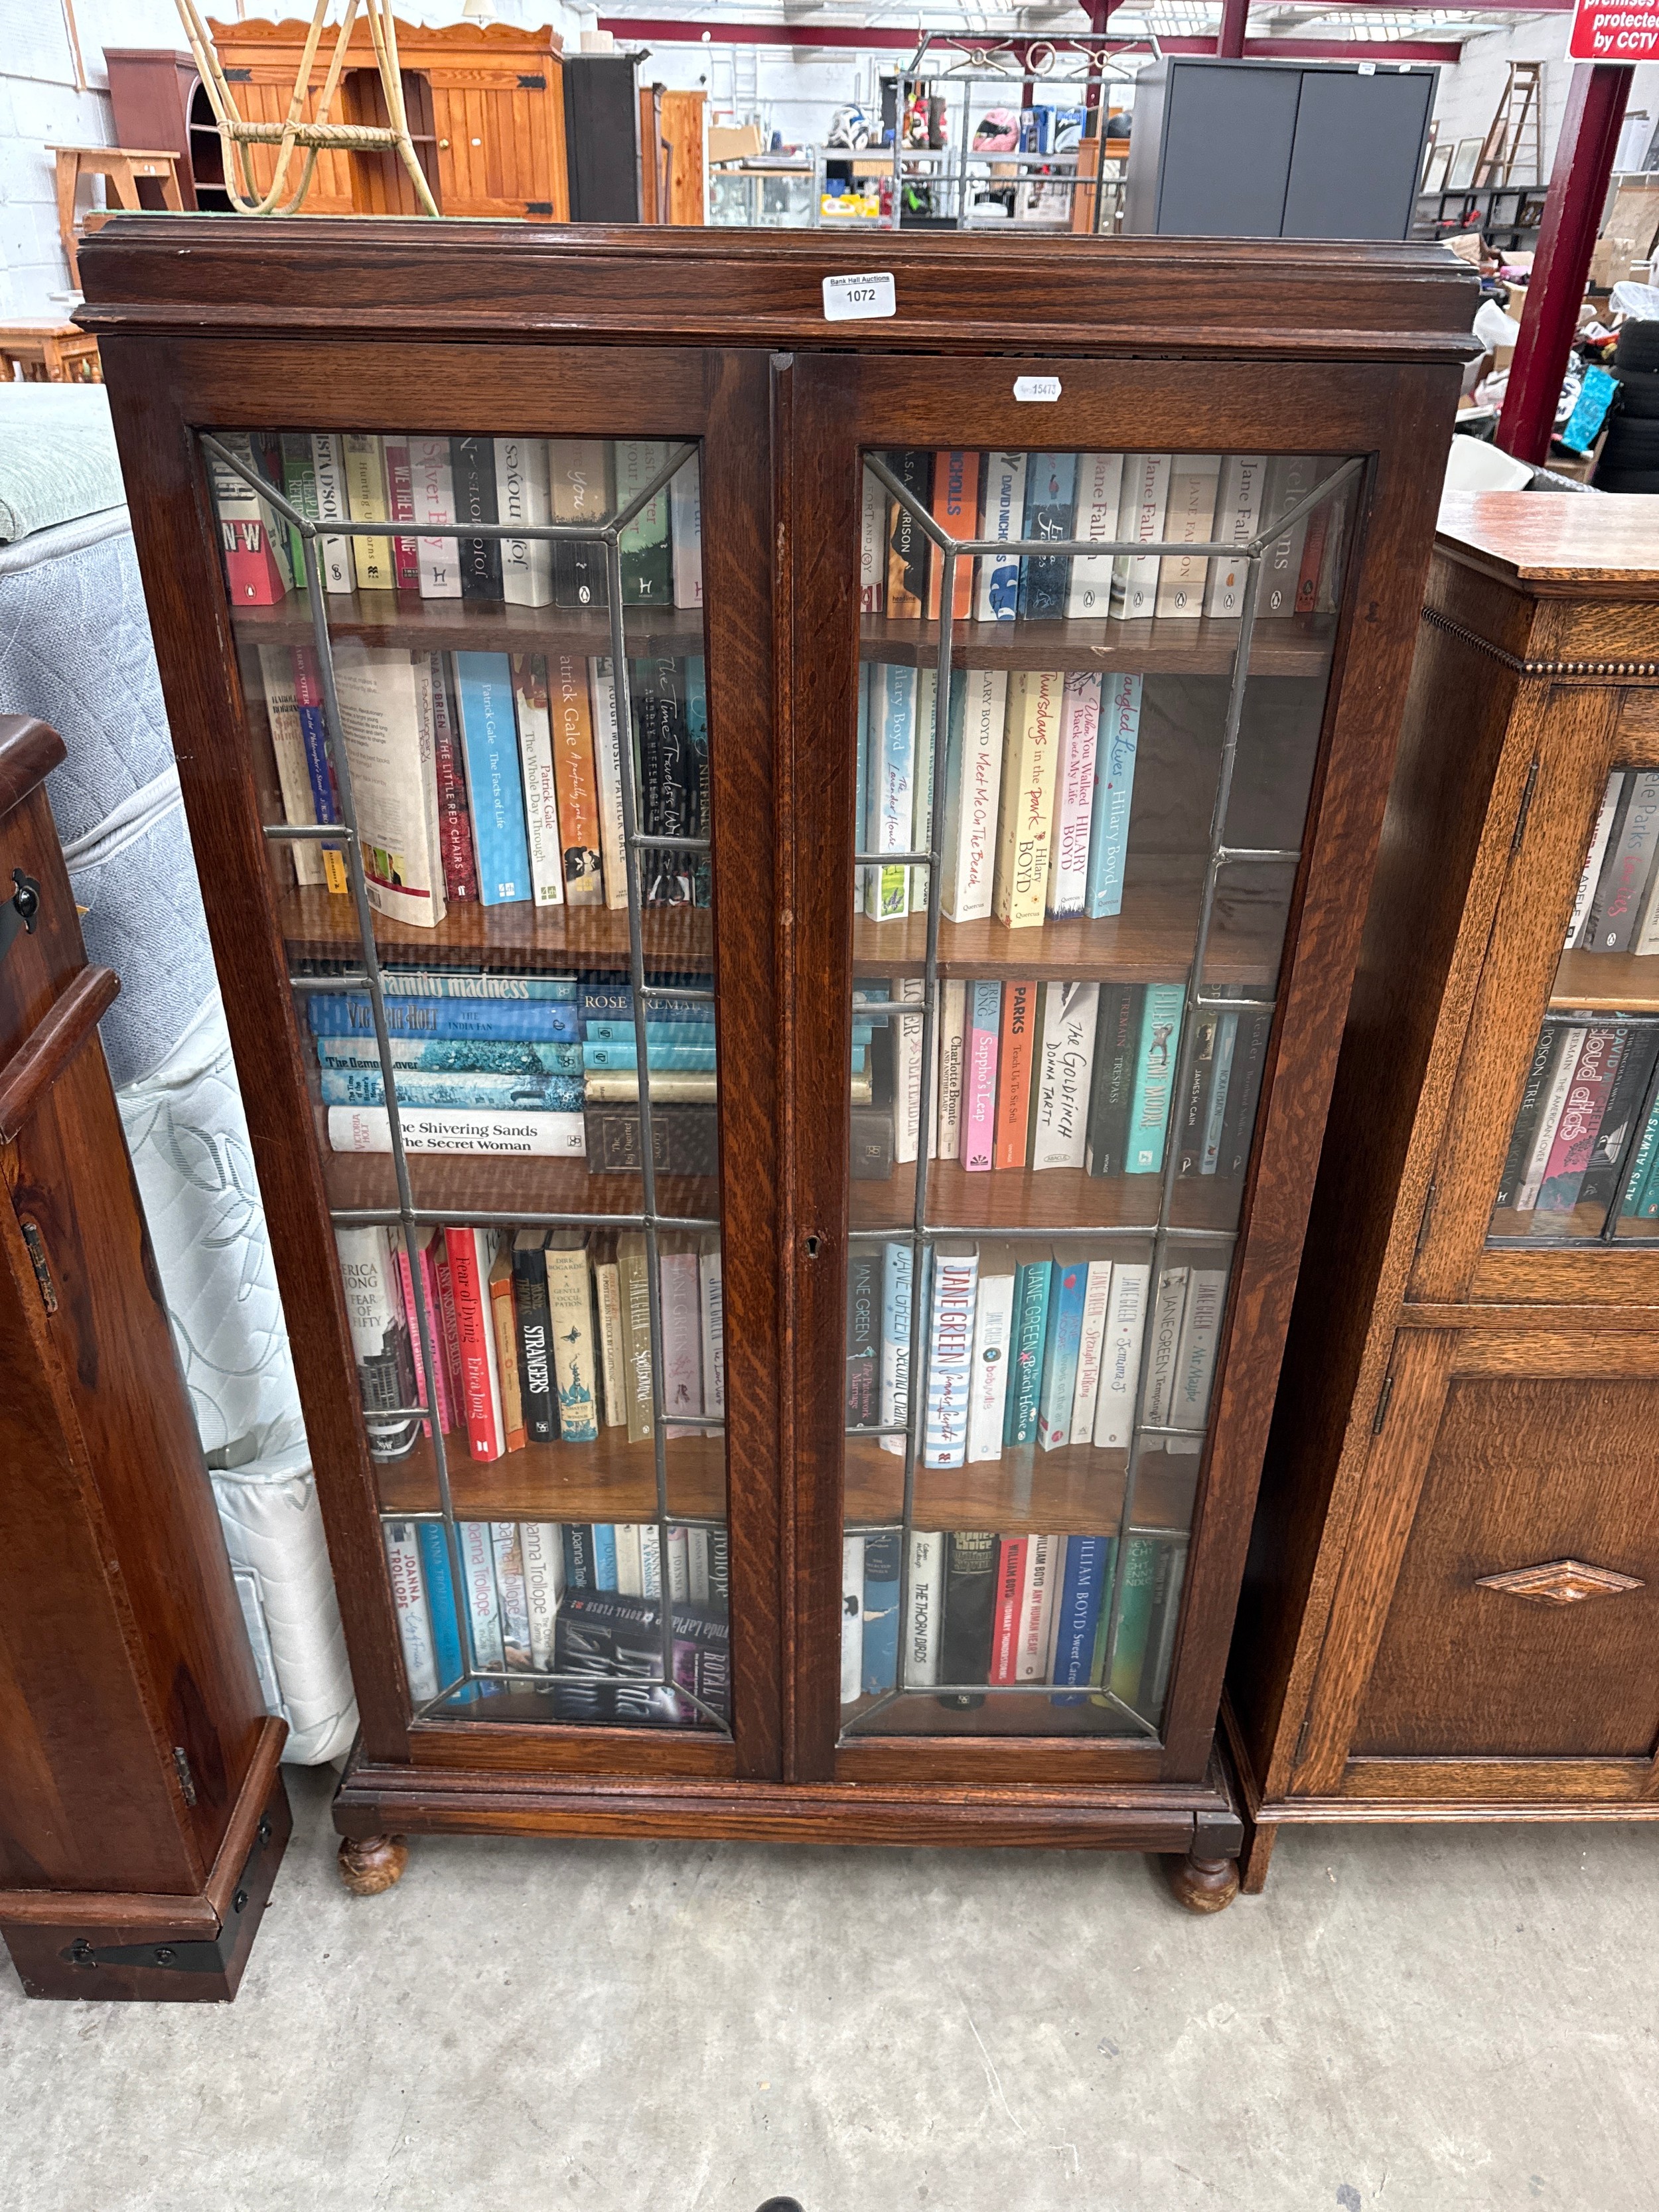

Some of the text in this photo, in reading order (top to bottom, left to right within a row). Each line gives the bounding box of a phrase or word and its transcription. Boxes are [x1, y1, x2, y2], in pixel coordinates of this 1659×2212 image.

[1593, 12, 1659, 30] protecte
[1594, 32, 1658, 52] by CCTV
[847, 289, 875, 302] 1072
[359, 463, 370, 506] Hunting
[423, 441, 441, 504] Silver
[505, 445, 524, 518] moyes
[567, 470, 587, 510] you
[999, 475, 1012, 506] DAVID
[1094, 457, 1110, 498] Jane
[1144, 457, 1160, 498] Jane
[1240, 461, 1257, 501] Jane
[1187, 479, 1200, 515] JANE
[473, 538, 488, 578] JOJO
[299, 674, 310, 705] POTTER
[421, 678, 432, 760] Revolutionary
[564, 709, 576, 746] Gale
[893, 713, 905, 751] Boyd
[1028, 672, 1057, 830] Thursdays park
[1068, 709, 1083, 804] Back Life
[1077, 697, 1099, 807] When You Walked
[433, 680, 463, 869] O'BRIEN THE RED CHAIRS
[1104, 673, 1141, 885] Tangled Lives Hilary Boyd
[541, 765, 556, 830] Patrick Gale
[969, 710, 990, 887] BOYD Meet Me The Beach
[1061, 824, 1075, 870] BOYD
[1072, 815, 1088, 876] HILARY
[1628, 805, 1657, 849] Parks
[1016, 841, 1034, 893] BOYD
[1033, 848, 1047, 883] Hilary
[963, 903, 985, 911] Quercus
[1015, 911, 1040, 919] Quercus
[1098, 899, 1119, 907] Quercus
[1573, 875, 1589, 917] ADELE
[381, 971, 529, 998] family madness
[585, 995, 627, 1009] ROSE
[977, 982, 987, 1017] JONG
[988, 982, 997, 1016] ERICA
[406, 1004, 438, 1031] HOLT
[1012, 987, 1026, 1034] PARKS
[326, 1057, 348, 1068] The
[1110, 997, 1131, 1103] TREMAIN TRESPASS
[1523, 1029, 1555, 1110] POISON TREE
[1607, 1029, 1628, 1067] DAVID
[948, 1036, 962, 1125] Charlotte Bronte
[973, 1037, 992, 1122] Sappho's Leap
[1042, 1043, 1064, 1126] DONNA TARTT
[1058, 1022, 1086, 1138] The GOLDFINCH
[1219, 1070, 1228, 1089] NORA
[1140, 1086, 1165, 1129] MOORE
[1548, 1096, 1561, 1138] AMERICAN
[1561, 1086, 1595, 1140] atlas
[352, 1114, 361, 1149] VICTORIA
[419, 1123, 538, 1138] Shivering Sands
[427, 1139, 532, 1151] Secret Woman
[1625, 1119, 1658, 1201] ALYS, ALWAYS
[342, 1264, 377, 1276] ERICA
[346, 1276, 378, 1289] JONG
[672, 1268, 687, 1301] JANE
[352, 1294, 376, 1305] FEAR
[358, 1305, 371, 1316] OF
[855, 1264, 871, 1342] JANE GREEN
[895, 1252, 911, 1341] JANE GREEN
[938, 1266, 971, 1363] JANE GREEN
[354, 1317, 381, 1327] FIFTY
[457, 1258, 488, 1420] Fear Dying Erica Jong
[673, 1304, 687, 1351] GREEN
[1156, 1296, 1177, 1374] JANE GREEN
[450, 1341, 461, 1376] BLUES
[524, 1326, 549, 1394] STRANGERS
[1019, 1267, 1044, 1429] JANE GREEN Beach House
[1084, 1327, 1100, 1365] Straight
[1116, 1338, 1131, 1380] Jemima
[631, 1350, 651, 1402] Spellbound
[862, 1374, 871, 1418] Patchwork
[983, 1366, 997, 1409] babyville
[1187, 1363, 1202, 1403] Maybe
[571, 1530, 584, 1564] Joanna
[956, 1540, 992, 1550] Choice
[390, 1550, 408, 1609] TROLLOPE
[404, 1555, 419, 1603] JOANNA
[473, 1567, 490, 1616] Trollope
[504, 1565, 519, 1615] Trollope
[530, 1564, 548, 1614] Trollope
[672, 1555, 682, 1591] JOANNA
[1029, 1534, 1048, 1629] WILLIAM BOYD HUMAN
[585, 1602, 614, 1615] FLUSH
[915, 1584, 928, 1639] THE THORN
[999, 1544, 1019, 1679] WILLIAM BOYD THUNDERSTORMS
[1071, 1592, 1089, 1659] BOYD Sweet
[703, 1651, 726, 1694] ROYAL
